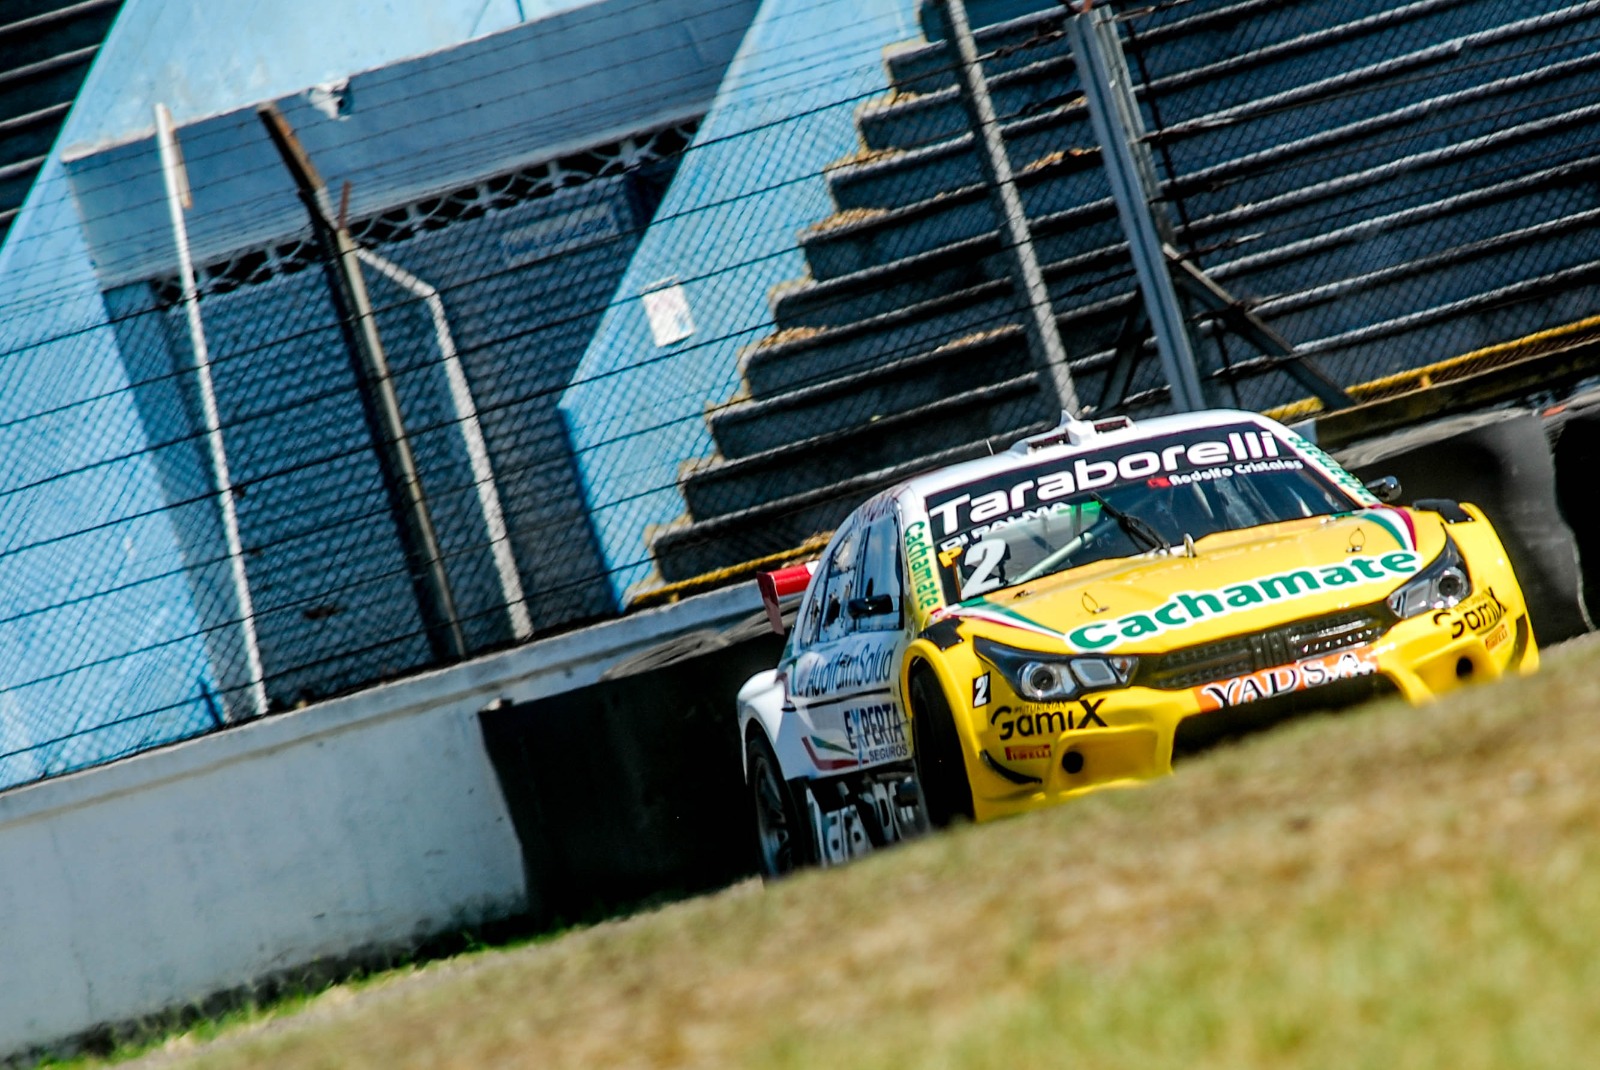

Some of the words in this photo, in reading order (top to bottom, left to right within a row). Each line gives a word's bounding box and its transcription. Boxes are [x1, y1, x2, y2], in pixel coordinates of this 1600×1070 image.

[929, 430, 1280, 536] Taraborelli
[1168, 467, 1234, 487] Rodolfo
[1234, 459, 1304, 476] Cristales
[940, 533, 969, 552] DI
[971, 502, 1071, 540] PALMA
[904, 520, 940, 610] Cachamate
[961, 539, 1007, 601] 2
[1068, 552, 1417, 650] Cachamate
[974, 674, 989, 707] 2
[843, 701, 906, 754] EXPERTA
[991, 697, 1108, 741] GamiX
[868, 743, 908, 762] SEGUROS
